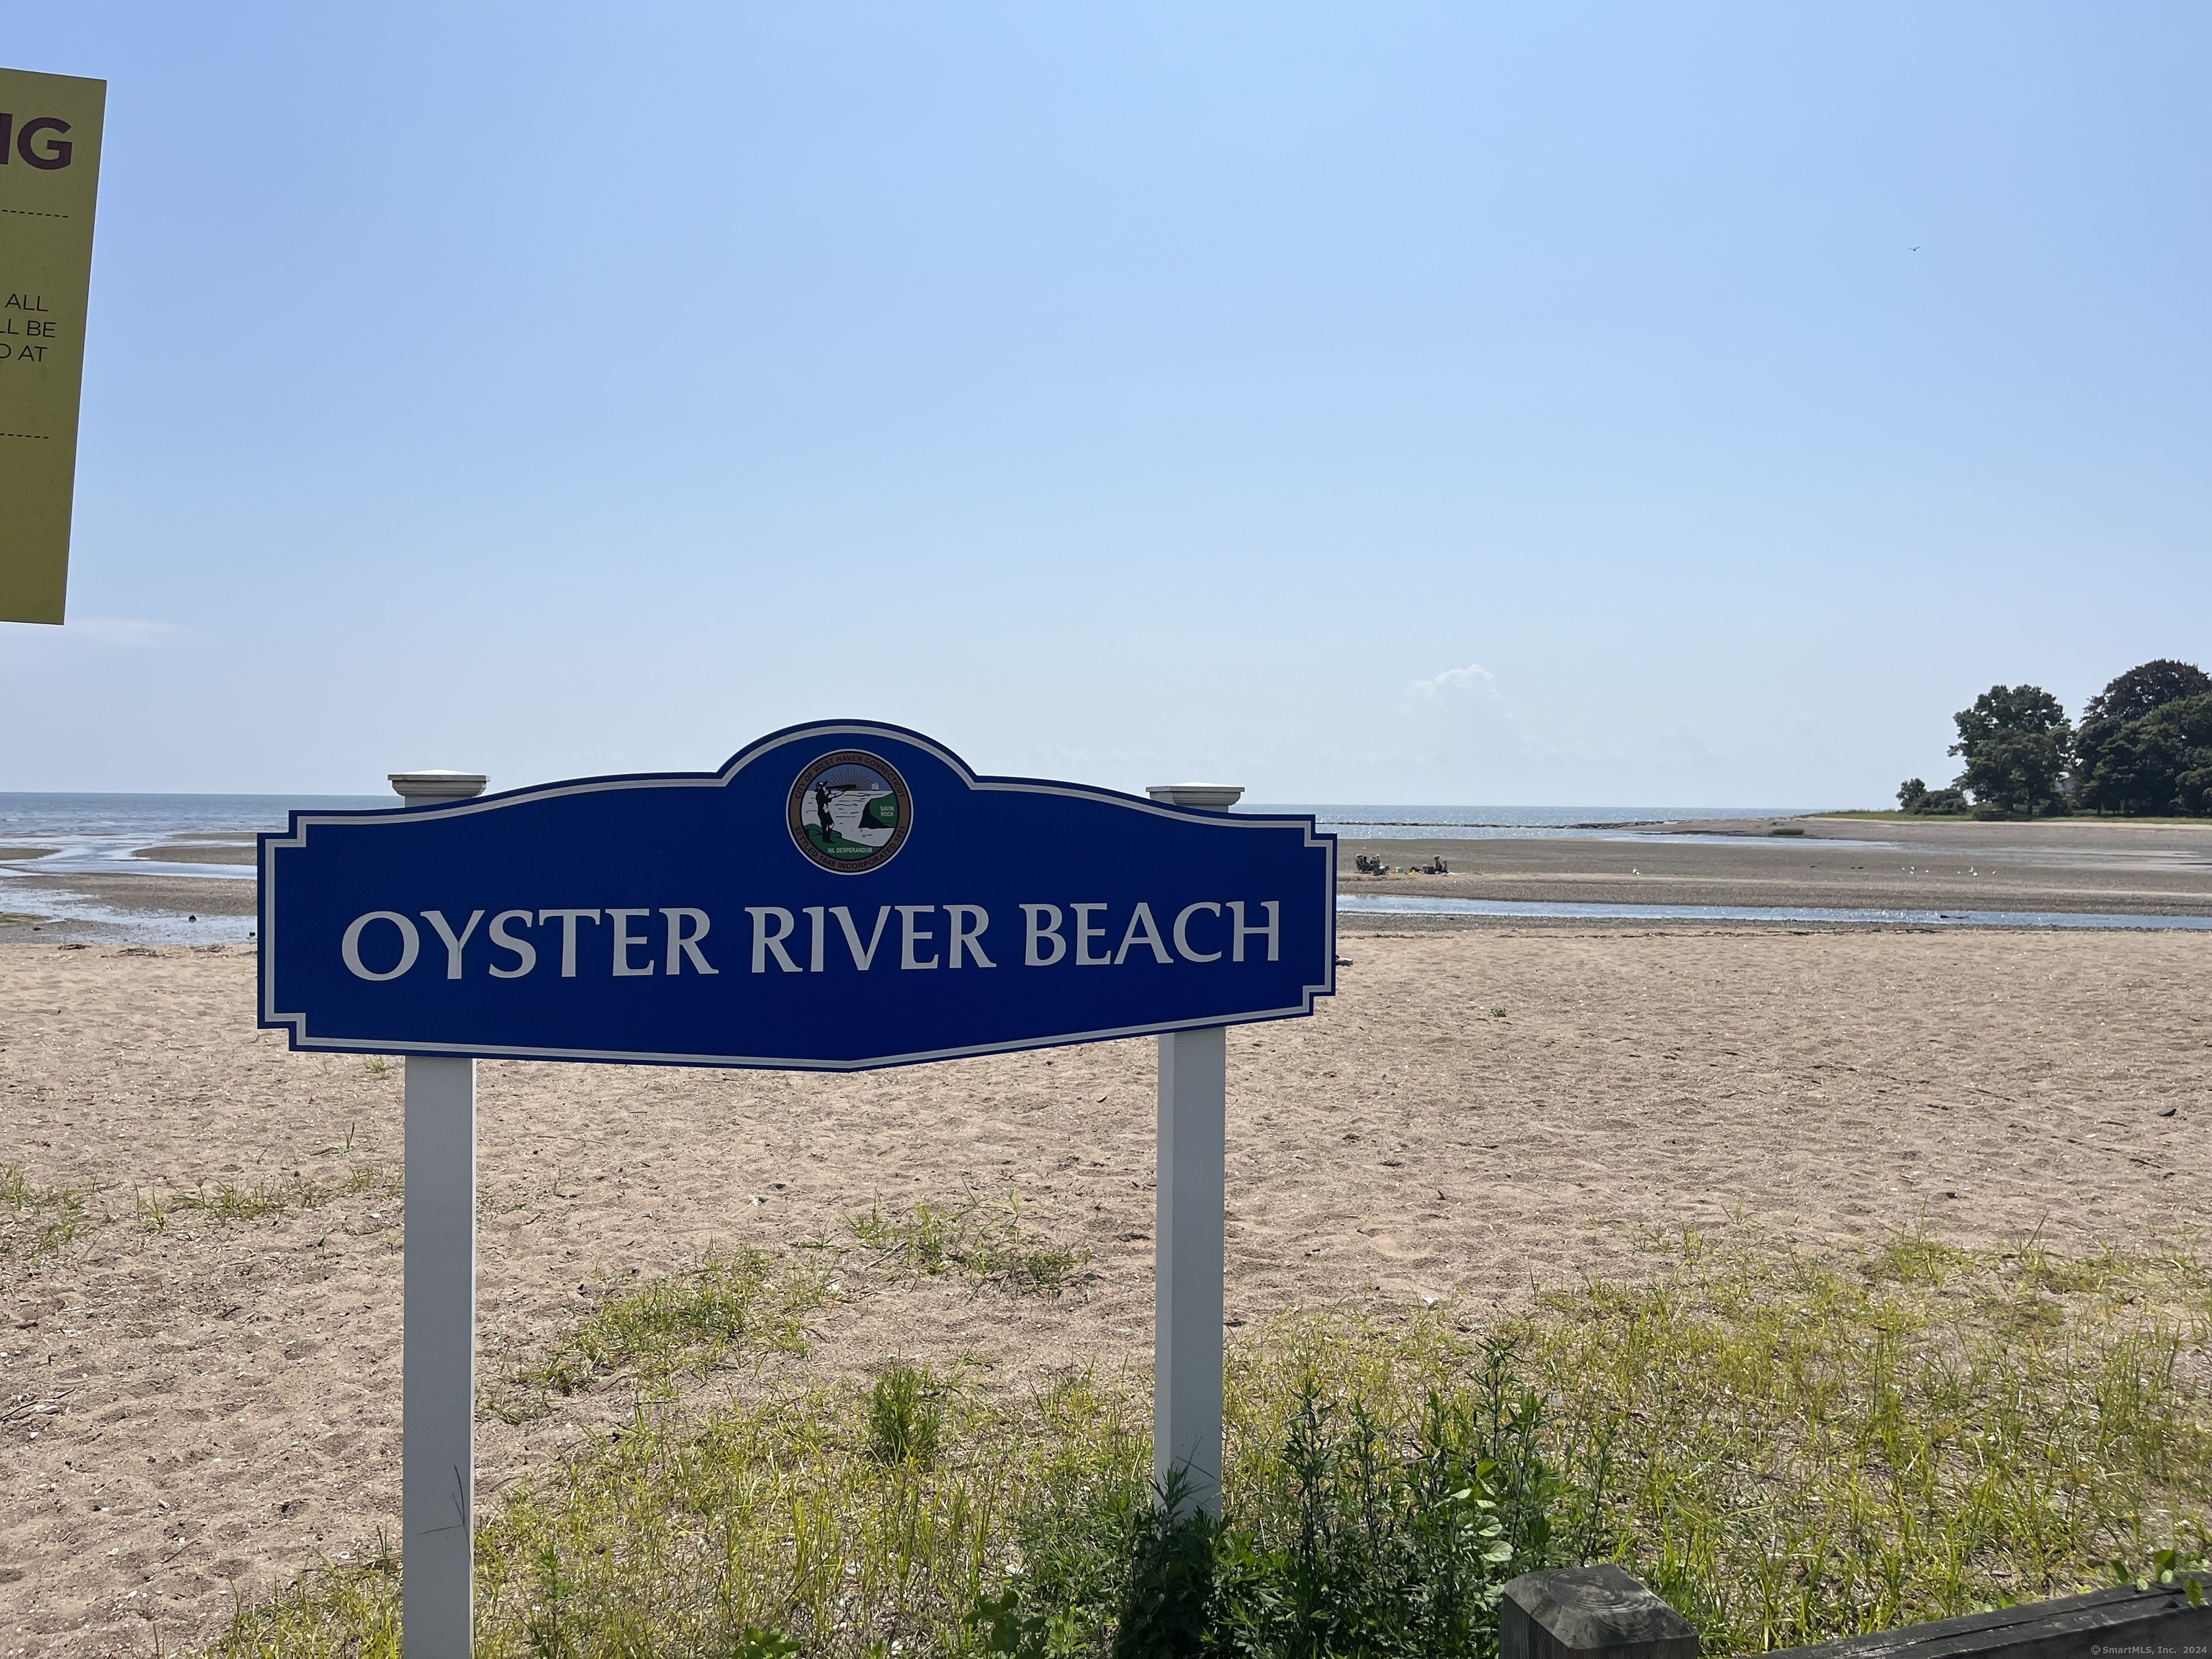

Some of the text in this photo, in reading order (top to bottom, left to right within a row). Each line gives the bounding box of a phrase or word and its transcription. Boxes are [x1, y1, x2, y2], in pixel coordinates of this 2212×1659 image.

[4, 293, 49, 312] ALL
[27, 320, 57, 338] BE
[17, 346, 48, 361] AT
[795, 781, 806, 799] CITY
[804, 771, 814, 781] OF
[813, 757, 834, 773] WEST
[865, 757, 905, 798] CONNECTICUT
[794, 826, 906, 870] SETTLED 1648 INCORPORATED 1921
[341, 900, 1280, 981] OYSTER RIVER BEACH
